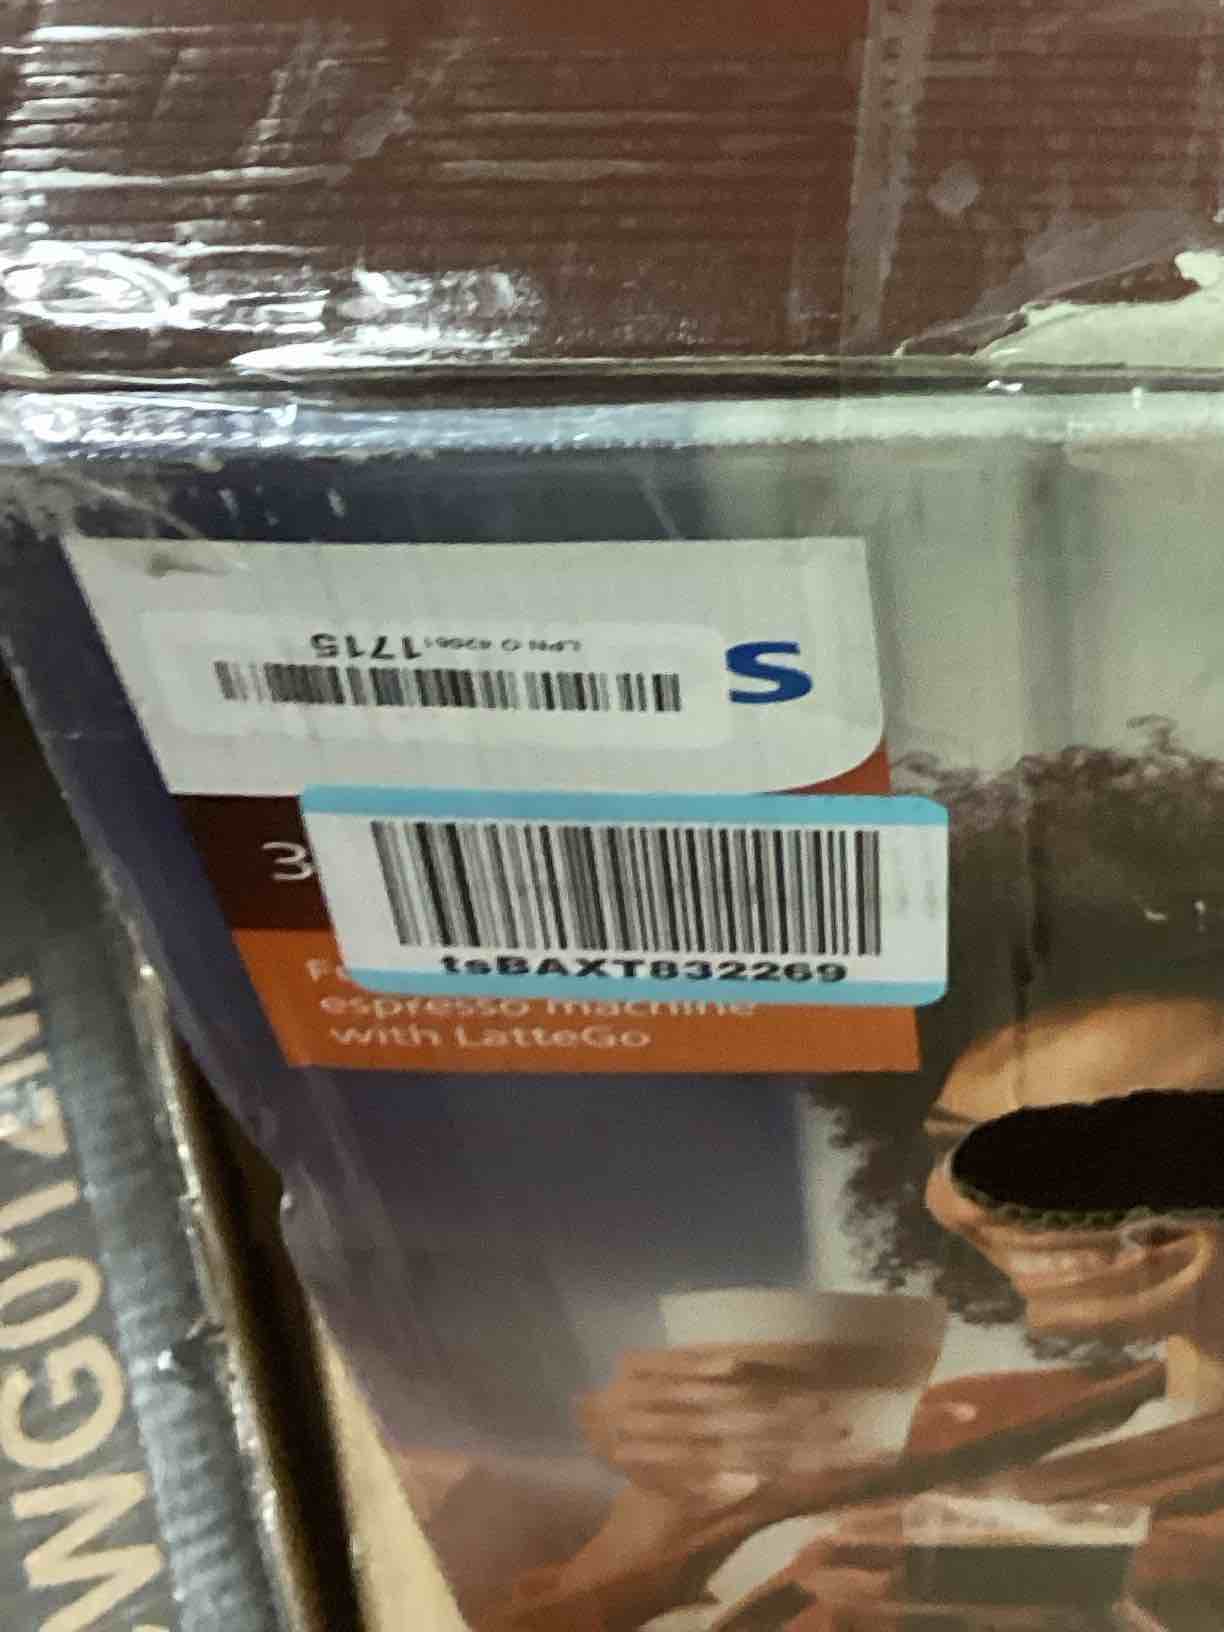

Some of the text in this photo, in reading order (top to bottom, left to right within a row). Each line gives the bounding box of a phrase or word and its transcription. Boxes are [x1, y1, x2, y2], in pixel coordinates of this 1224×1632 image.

[725, 641, 812, 703] S
[440, 955, 849, 982] tsBAXT832269
[320, 996, 530, 1020] espresso
[330, 1023, 652, 1050] with LatteGo
